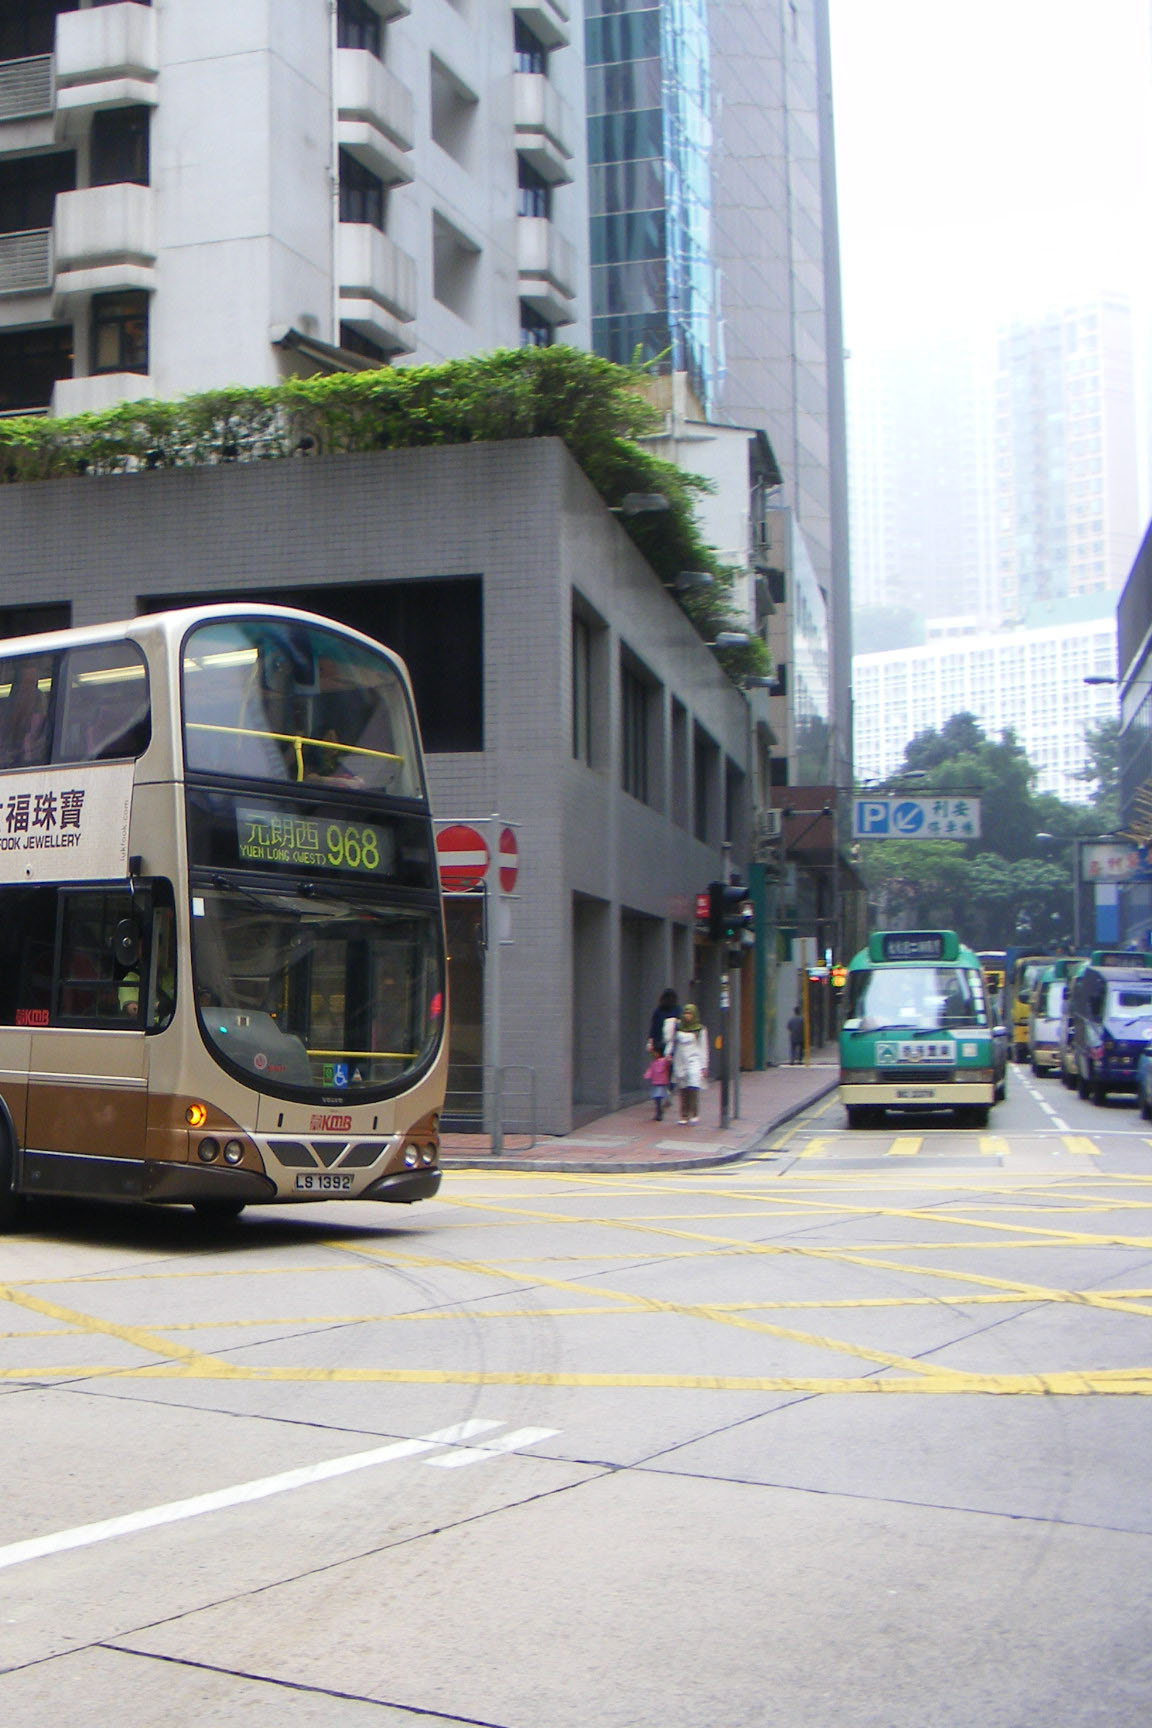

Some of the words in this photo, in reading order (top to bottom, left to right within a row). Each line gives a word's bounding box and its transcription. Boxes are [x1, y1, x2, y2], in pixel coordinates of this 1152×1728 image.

[863, 804, 885, 831] P
[24, 834, 81, 849] JEWELLERY
[246, 814, 318, 849] 元朗西
[327, 825, 379, 868] 968
[240, 845, 263, 858] YUEN
[267, 849, 289, 861] LONG
[293, 852, 326, 865] (WEST)
[26, 1009, 49, 1025] KMB
[322, 1115, 352, 1131] KMB
[296, 1176, 313, 1189] LS
[318, 1176, 350, 1189] 1392
